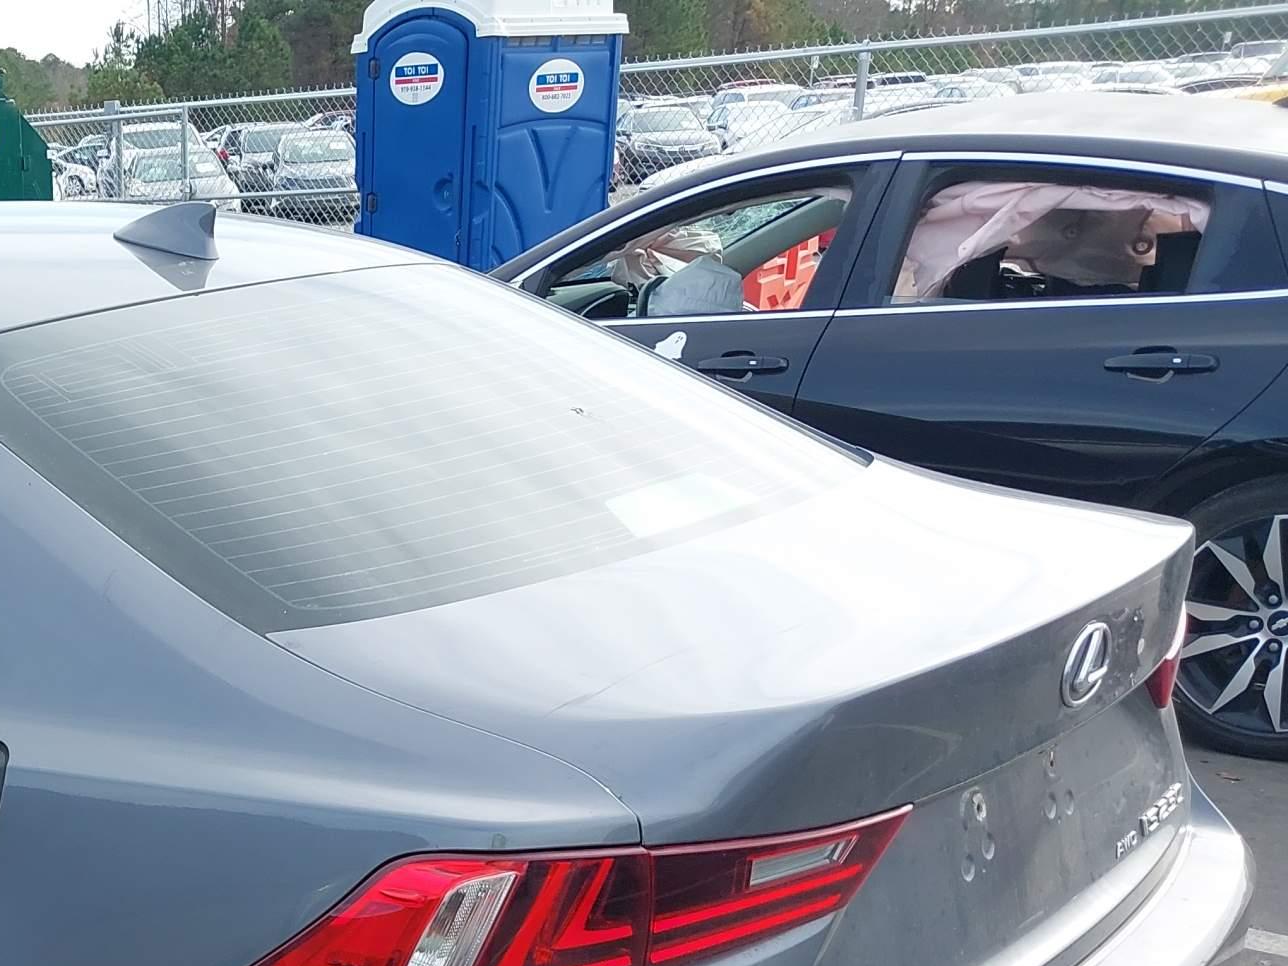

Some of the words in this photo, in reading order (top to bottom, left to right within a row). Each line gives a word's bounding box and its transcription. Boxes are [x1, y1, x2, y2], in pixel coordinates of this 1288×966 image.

[403, 66, 415, 75] TOI
[417, 65, 429, 74] TOI
[546, 75, 557, 84] TOI
[559, 74, 570, 83] TOI
[1115, 830, 1137, 860] AWD
